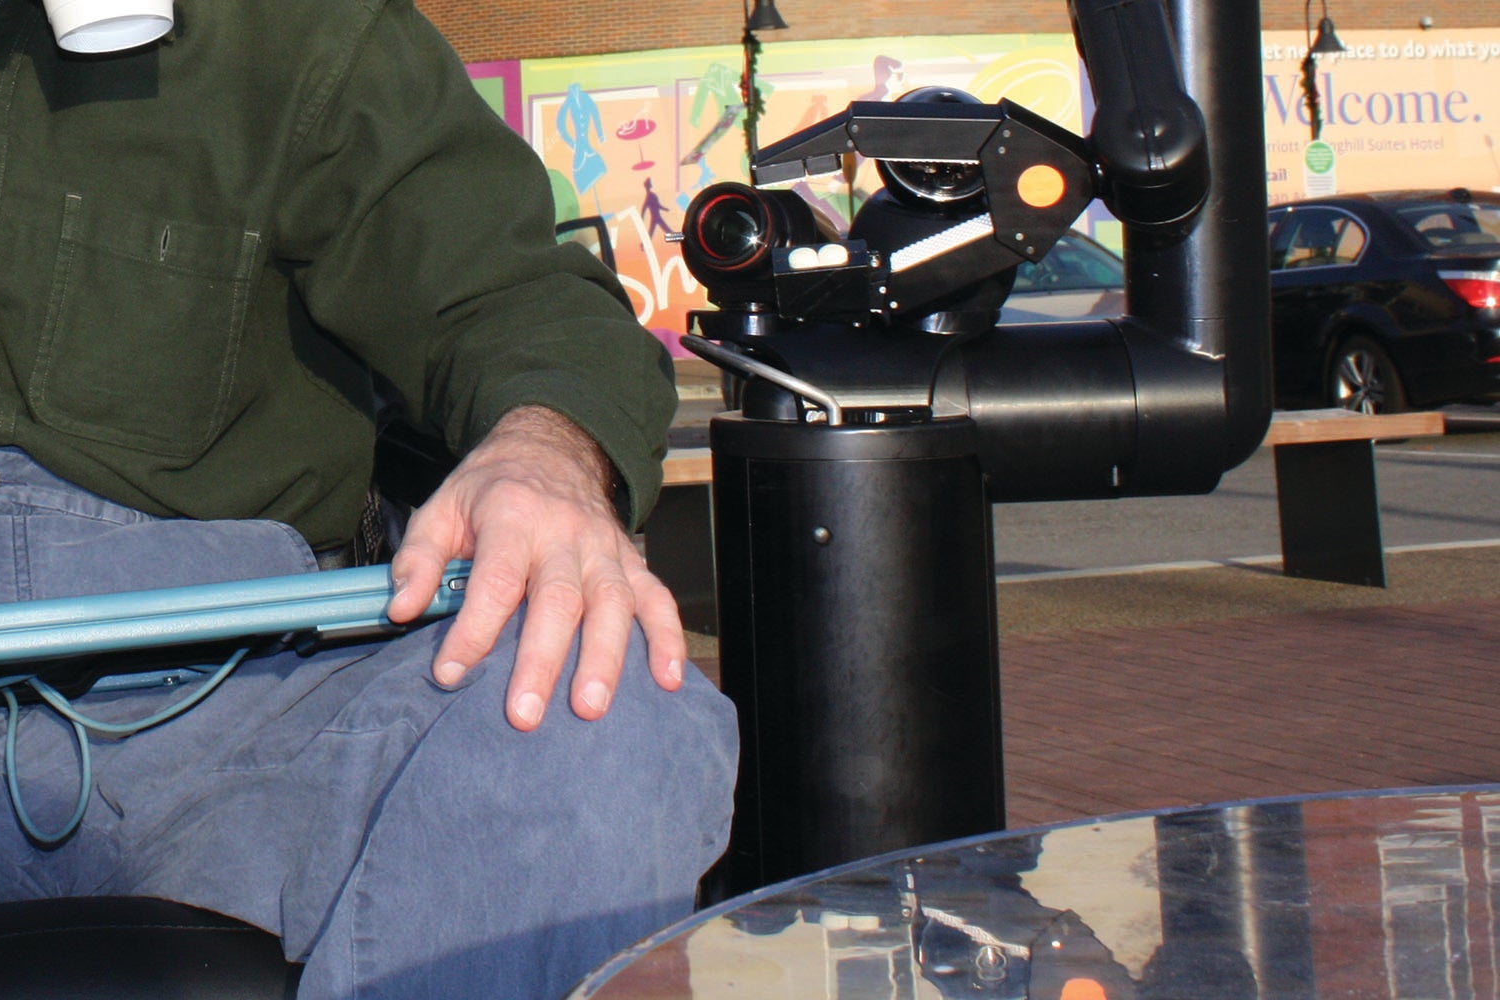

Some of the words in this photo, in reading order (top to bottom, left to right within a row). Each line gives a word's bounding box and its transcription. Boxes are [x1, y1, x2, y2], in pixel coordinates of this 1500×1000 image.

[1379, 43, 1400, 58] to
[1404, 40, 1426, 58] do
[1429, 40, 1477, 58] what
[1368, 137, 1408, 152] Suites
[1410, 135, 1445, 151] Hotel
